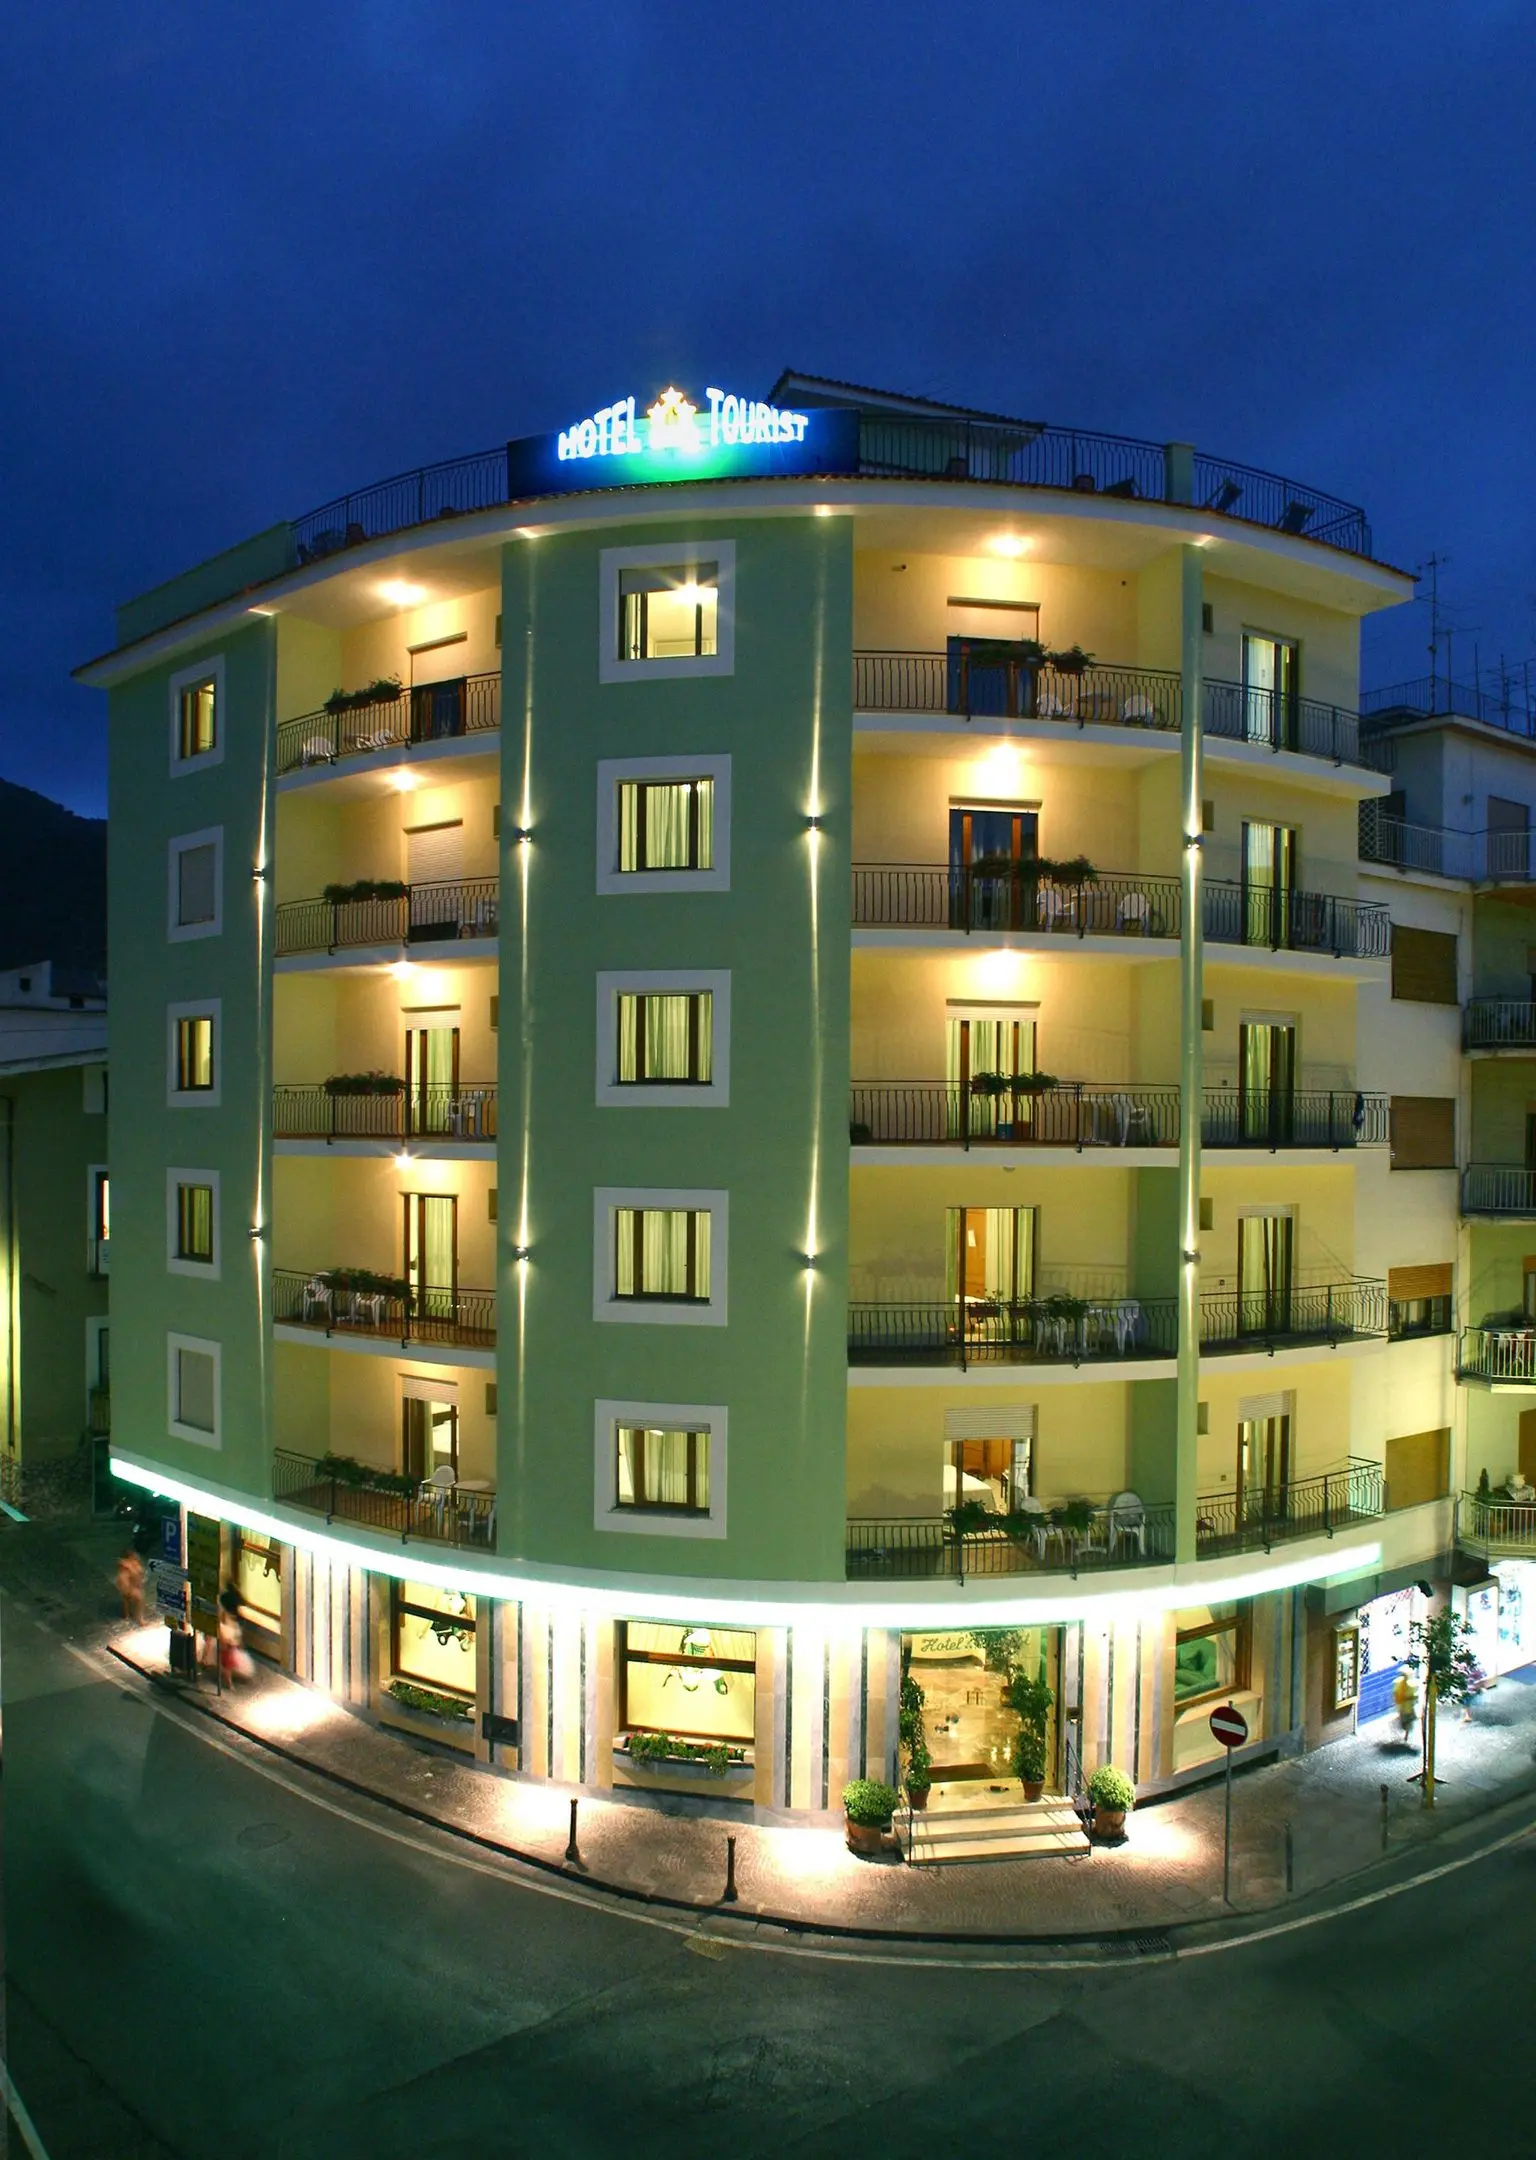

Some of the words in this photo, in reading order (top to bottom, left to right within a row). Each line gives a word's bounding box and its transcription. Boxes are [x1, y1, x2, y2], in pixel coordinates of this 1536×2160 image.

[558, 396, 641, 460] HOTEL
[706, 387, 808, 446] TOURIST
[165, 1521, 176, 1542] P
[921, 1636, 965, 1652] Hotel
